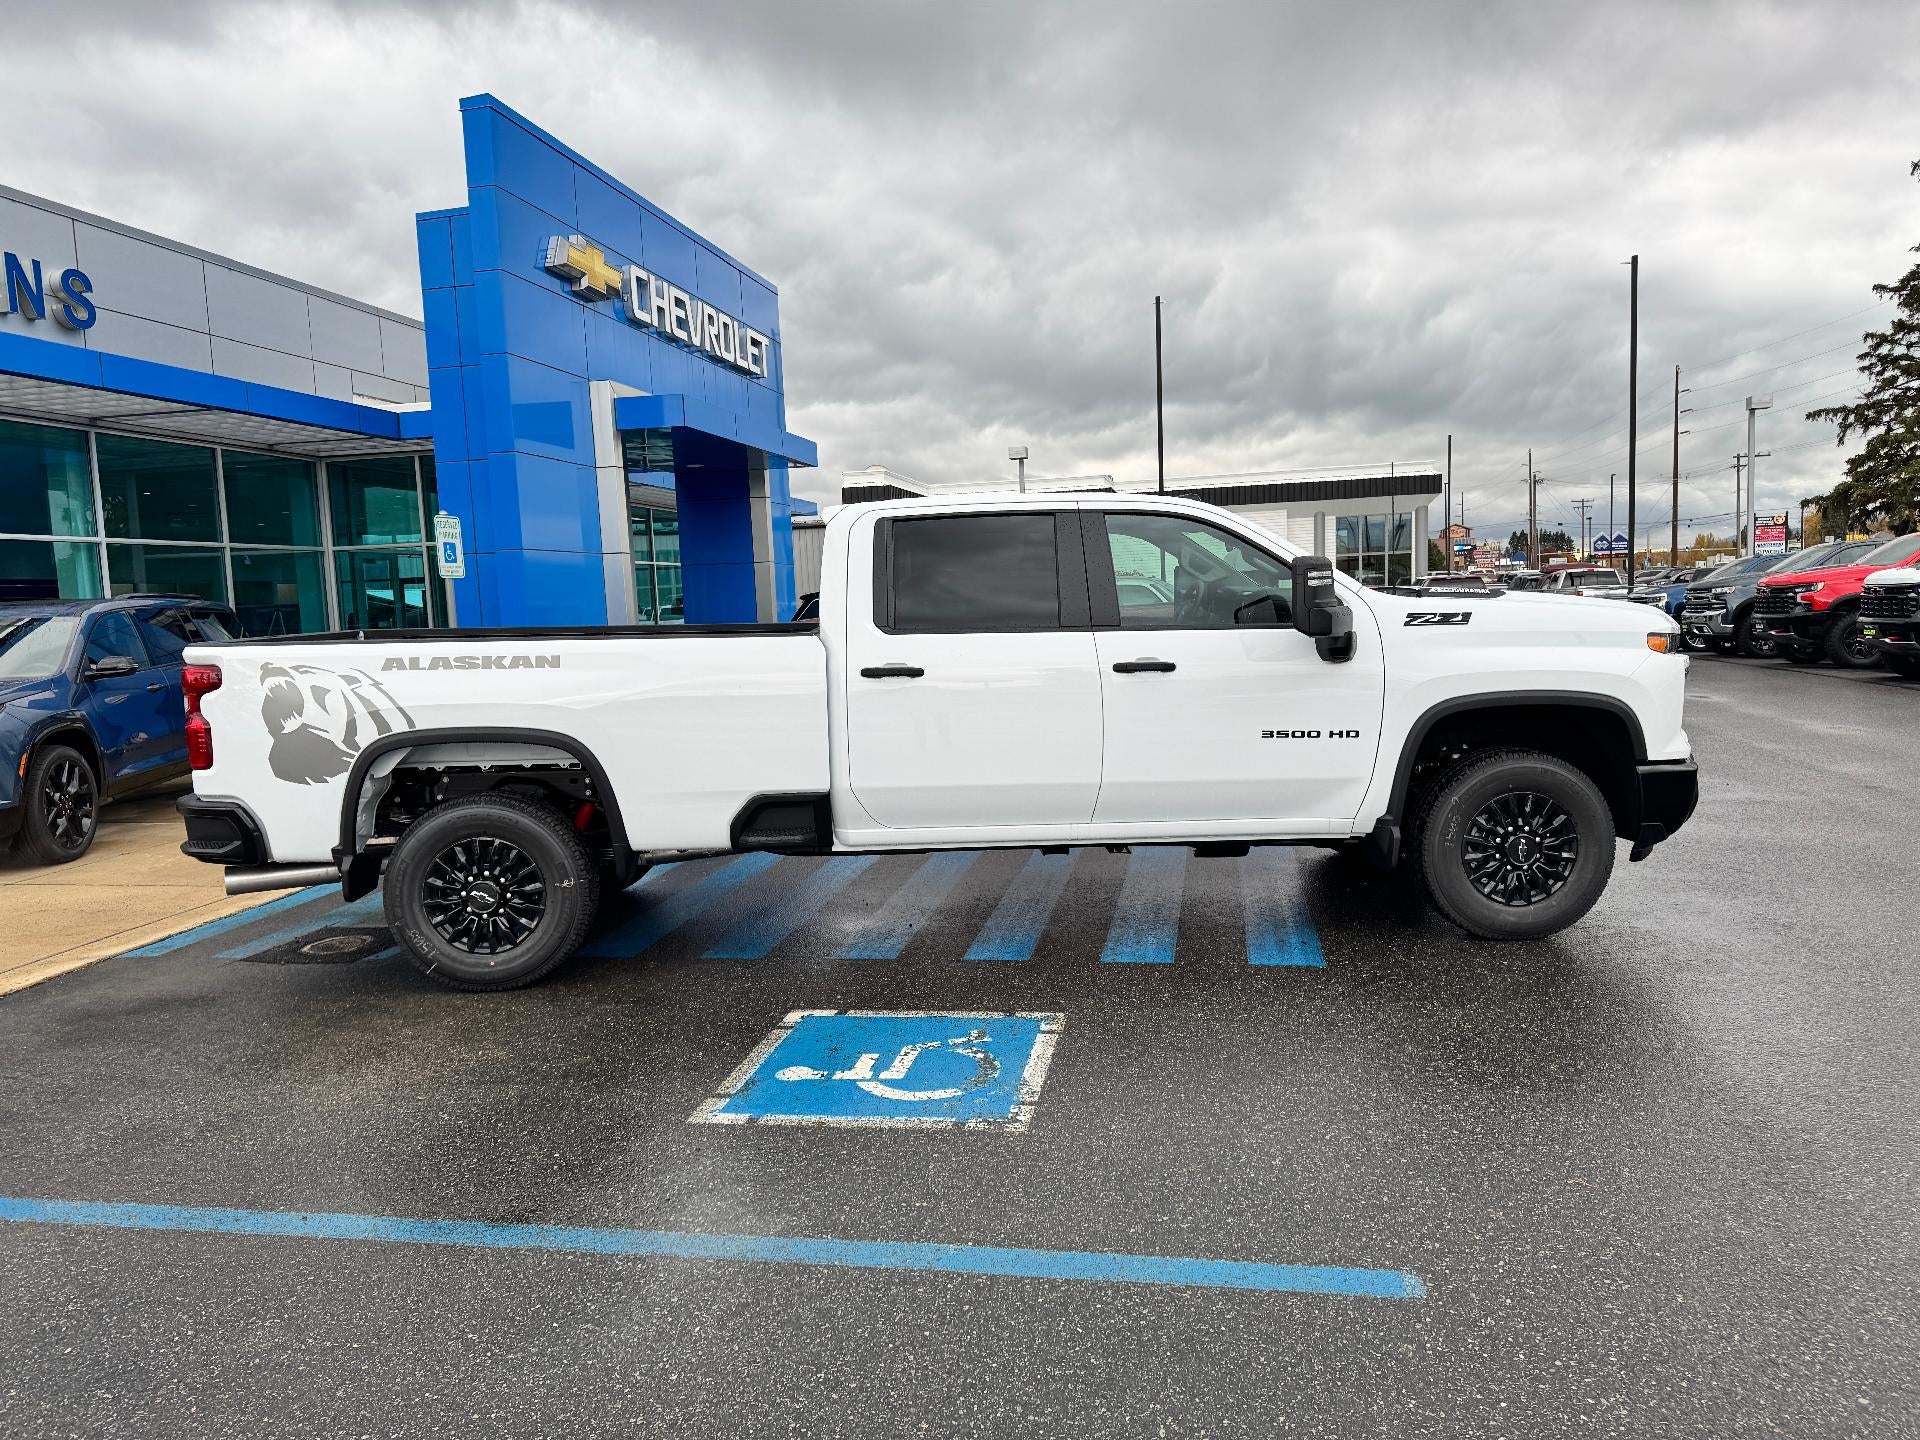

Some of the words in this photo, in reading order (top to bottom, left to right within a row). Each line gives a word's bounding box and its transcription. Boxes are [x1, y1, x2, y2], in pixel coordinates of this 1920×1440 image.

[627, 264, 769, 378] CHEVROLET
[1403, 611, 1473, 627] Z71
[380, 655, 561, 672] ALASKAN
[1261, 730, 1321, 739] 3500
[1328, 730, 1360, 739] HD
